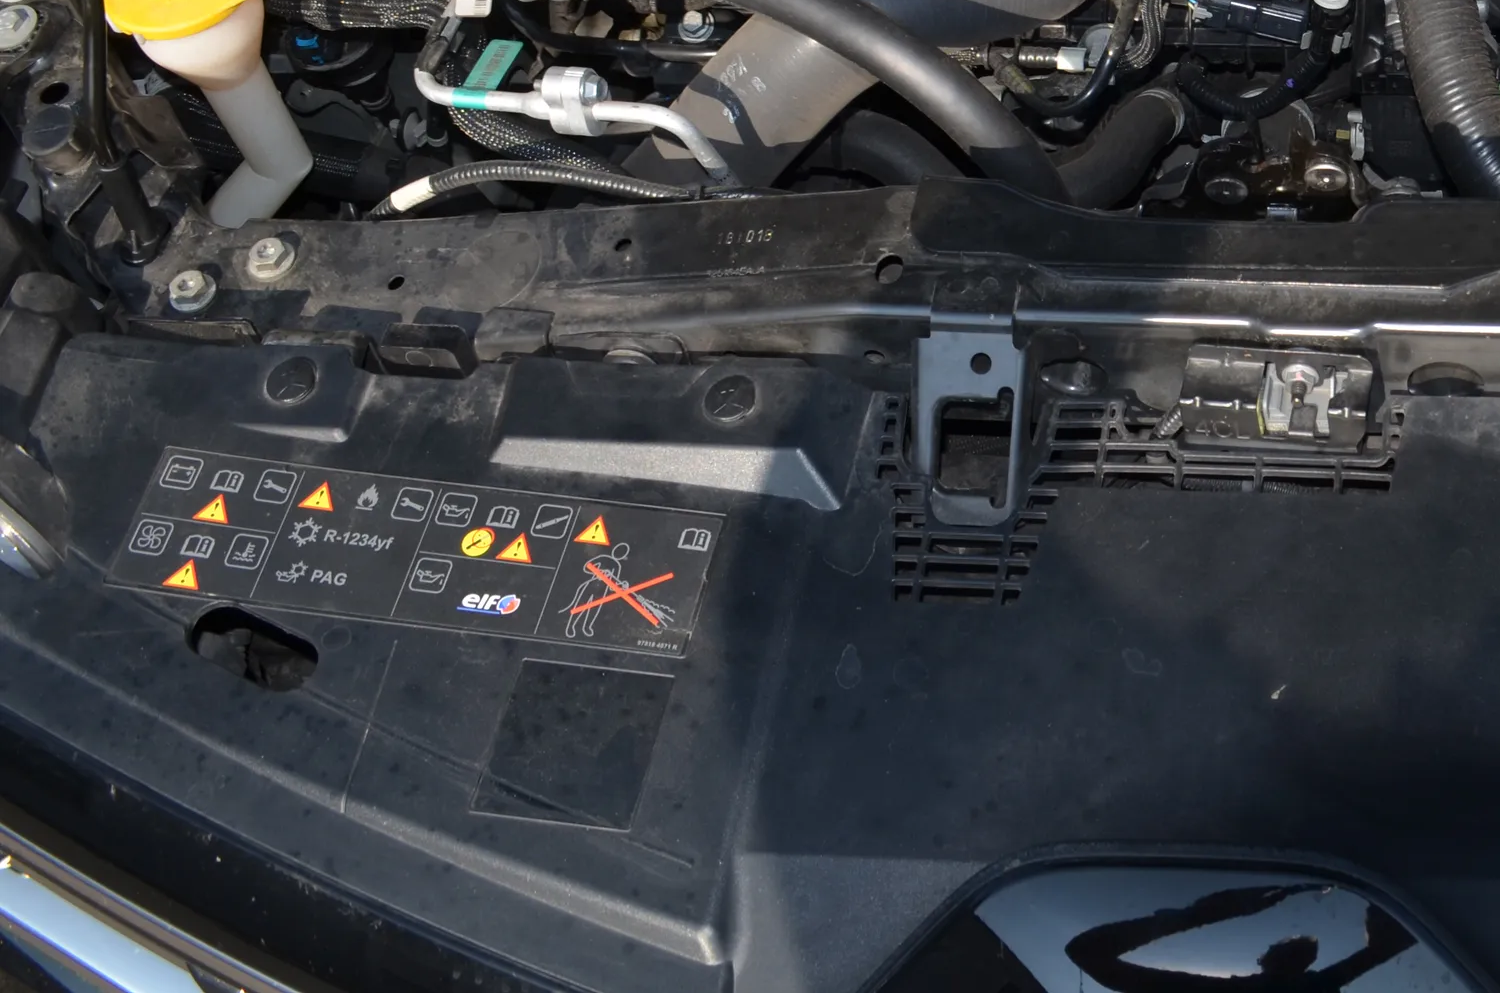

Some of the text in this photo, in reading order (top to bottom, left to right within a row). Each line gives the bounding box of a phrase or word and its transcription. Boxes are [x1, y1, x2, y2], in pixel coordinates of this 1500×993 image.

[323, 529, 394, 552] R-1234yf
[310, 569, 347, 586] PAG
[461, 593, 500, 610] elf
